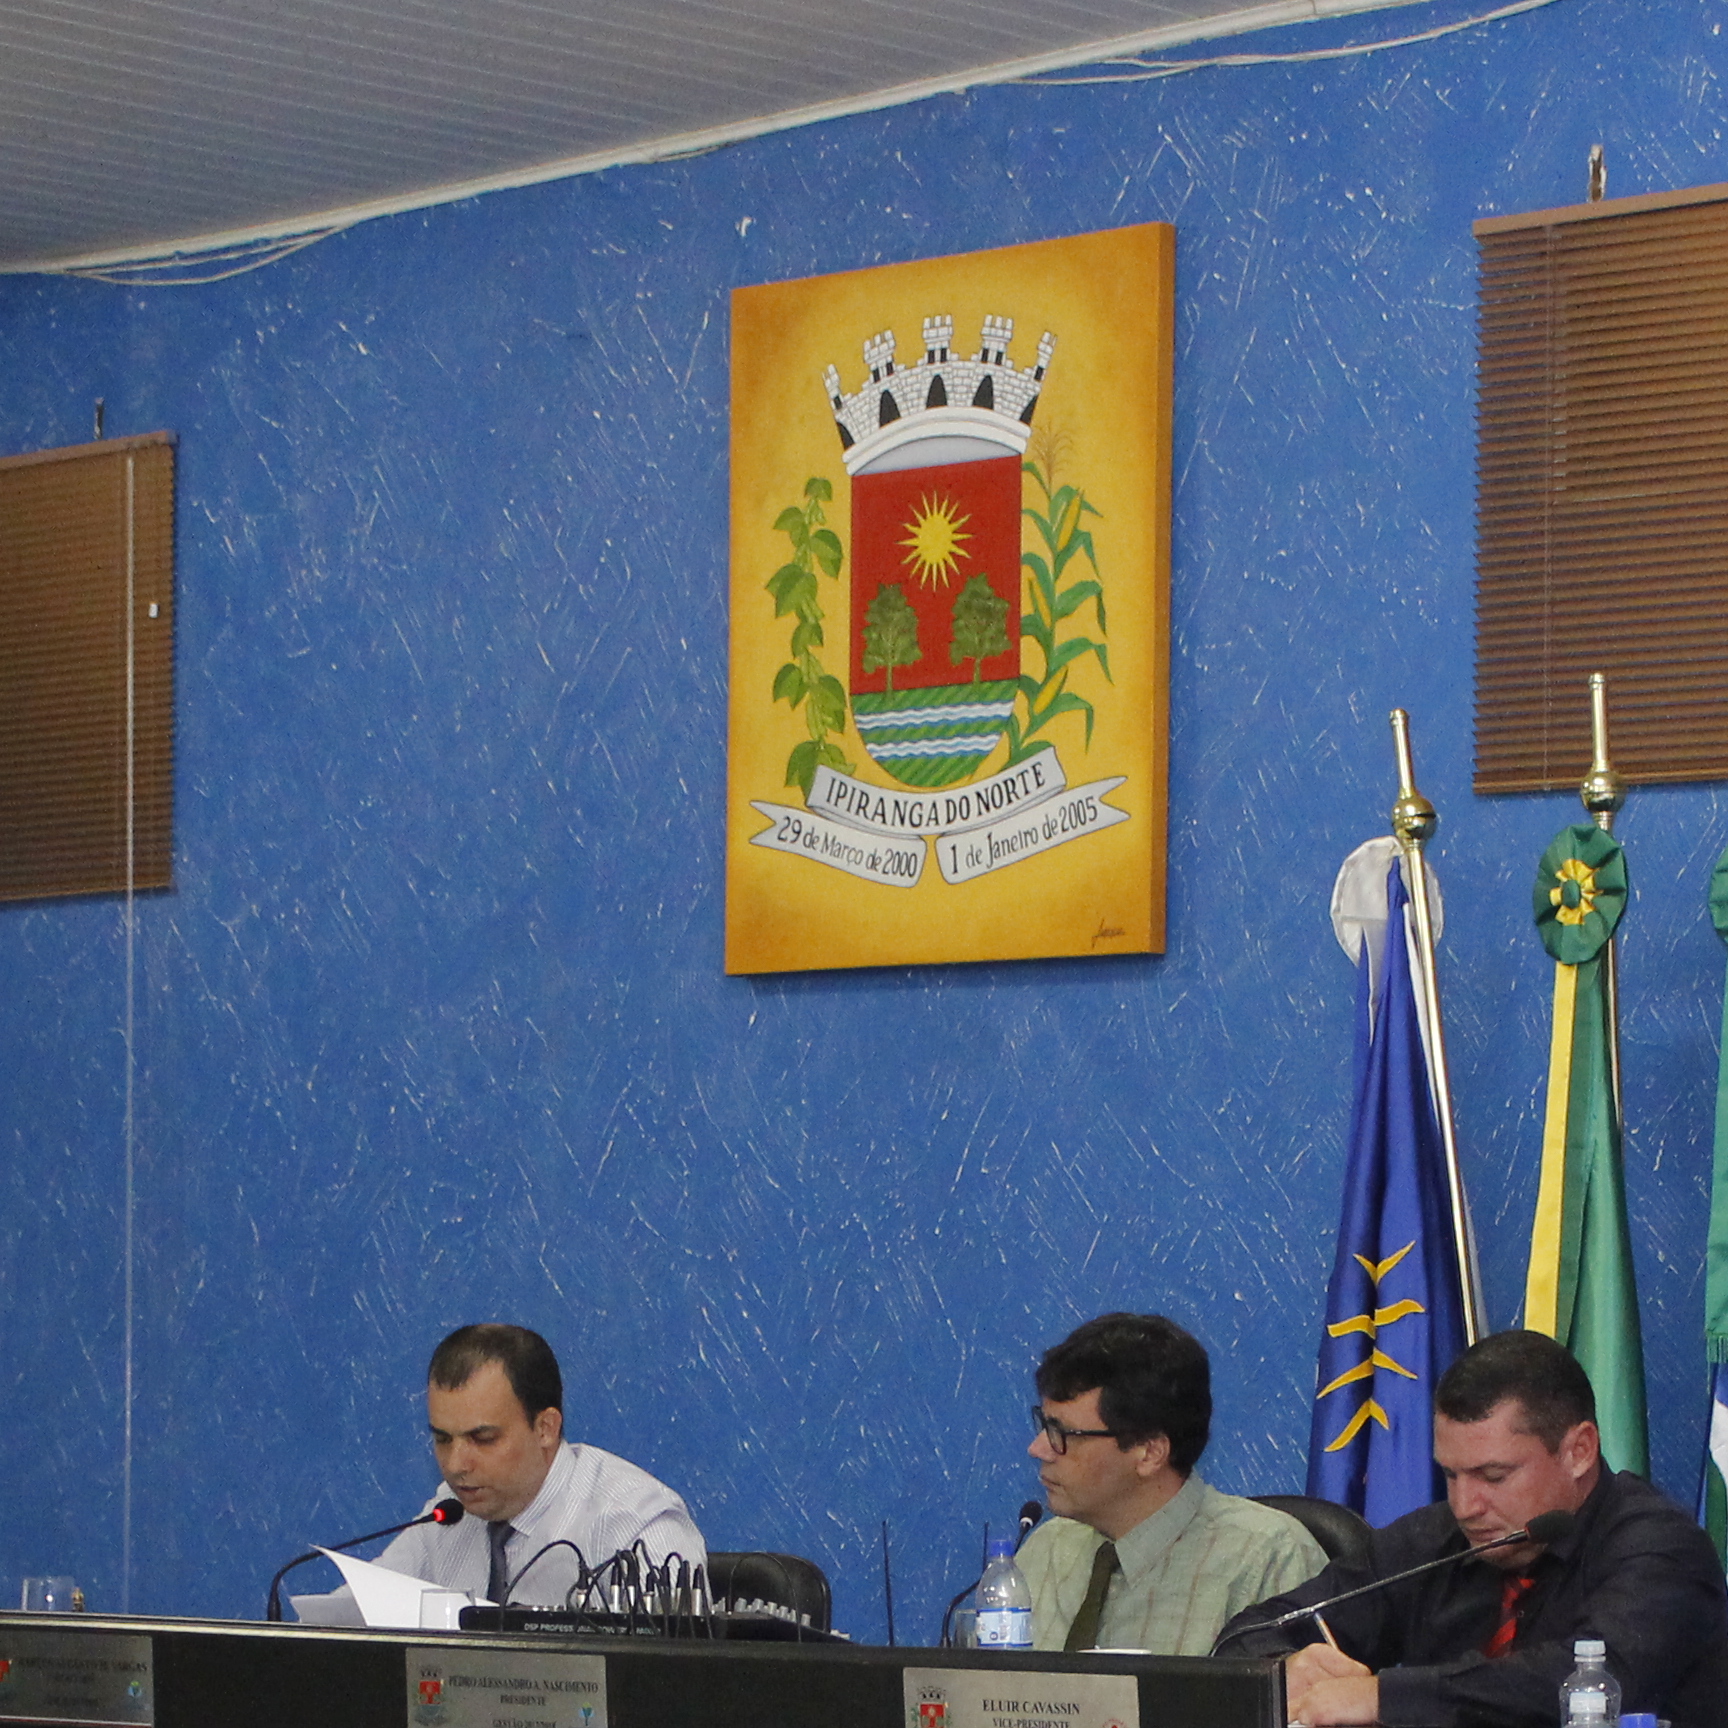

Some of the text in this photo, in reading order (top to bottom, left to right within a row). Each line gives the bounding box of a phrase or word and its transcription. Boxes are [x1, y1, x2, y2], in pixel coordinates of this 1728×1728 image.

[826, 760, 1047, 828] IPIRANGA DO NORTE
[776, 815, 918, 879] 29 de Março de 2000
[949, 795, 1099, 875] 1 de Janeiro de 2005
[448, 1675, 476, 1688] PEDRO
[477, 1677, 532, 1690] ALESSANDRO
[544, 1680, 599, 1693] NASCIMENTO
[500, 1694, 547, 1706] PRESIDENTE
[982, 1698, 1081, 1715] ELUIR CAVASSIN
